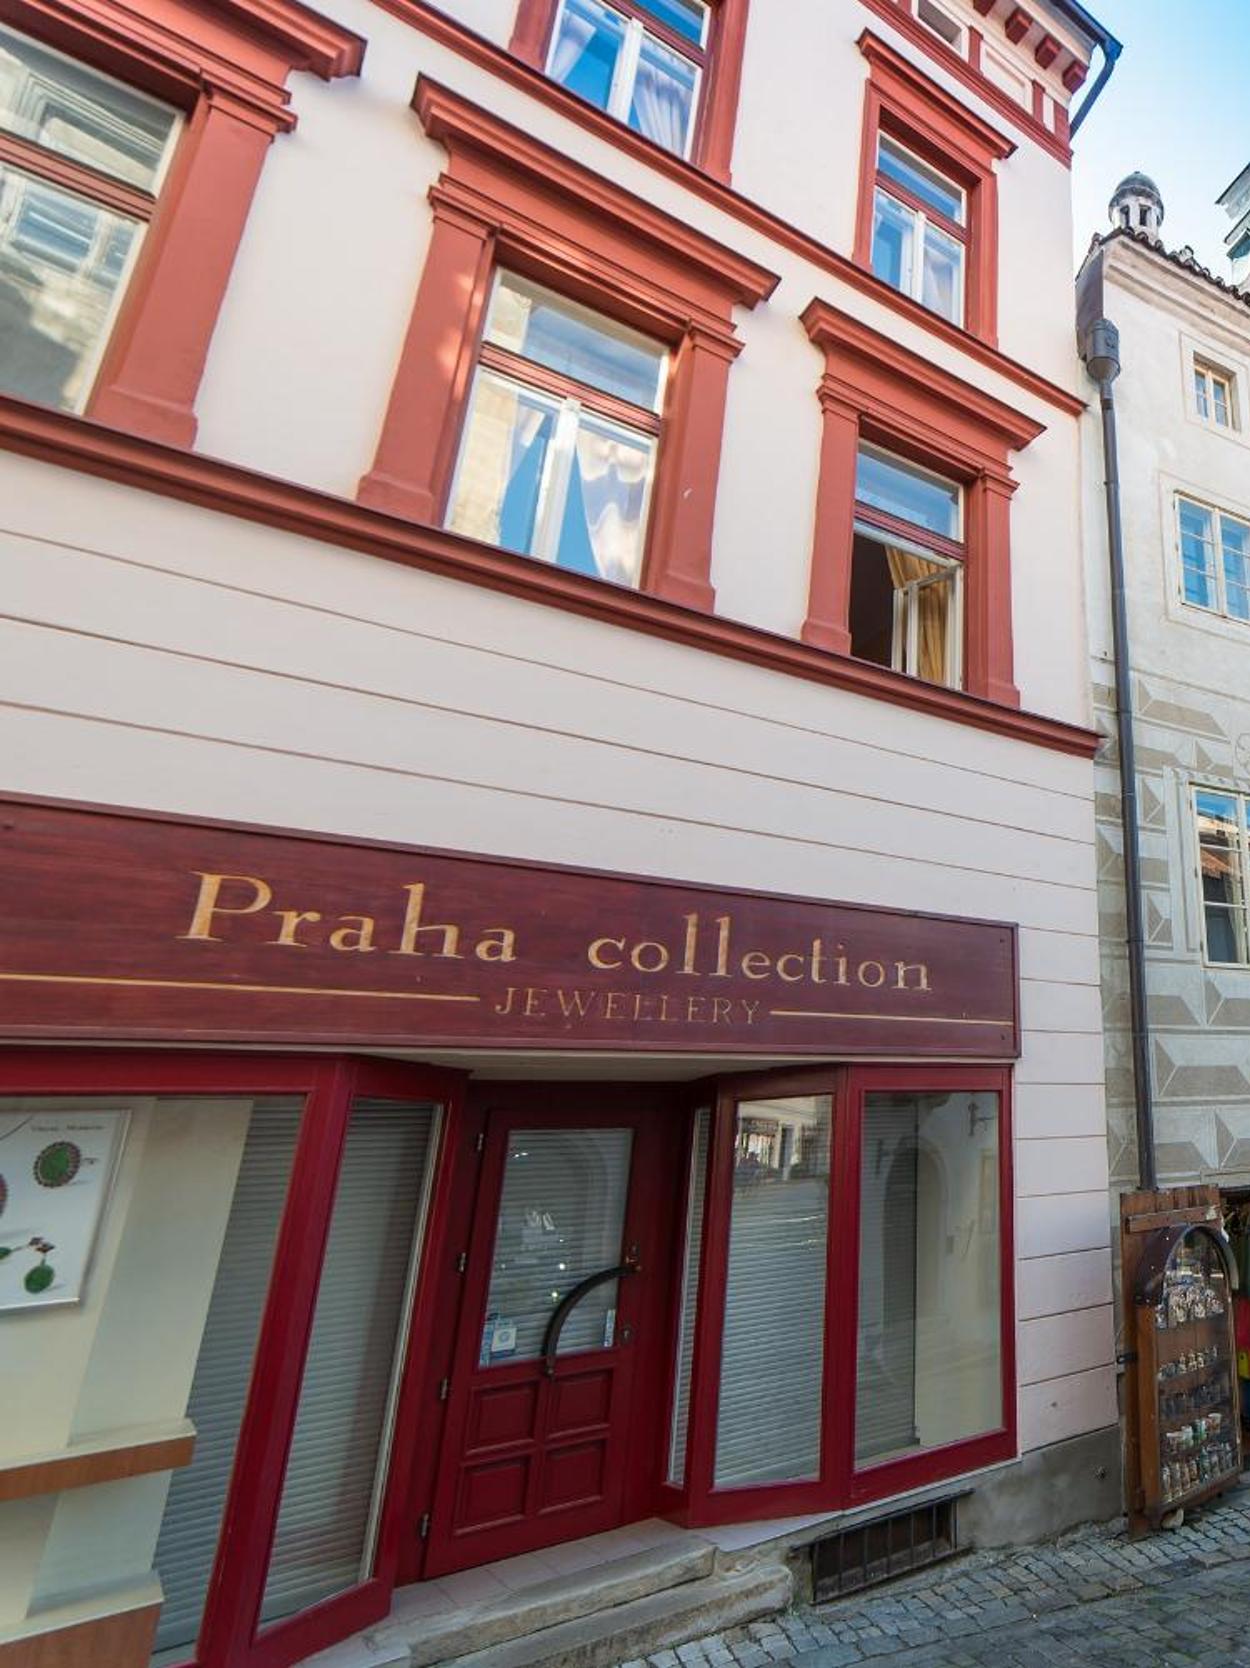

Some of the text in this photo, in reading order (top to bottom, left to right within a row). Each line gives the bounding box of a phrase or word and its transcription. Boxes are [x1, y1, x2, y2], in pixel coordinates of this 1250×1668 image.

[177, 870, 933, 991] Praha collection
[494, 986, 762, 1026] JEWELLERY
